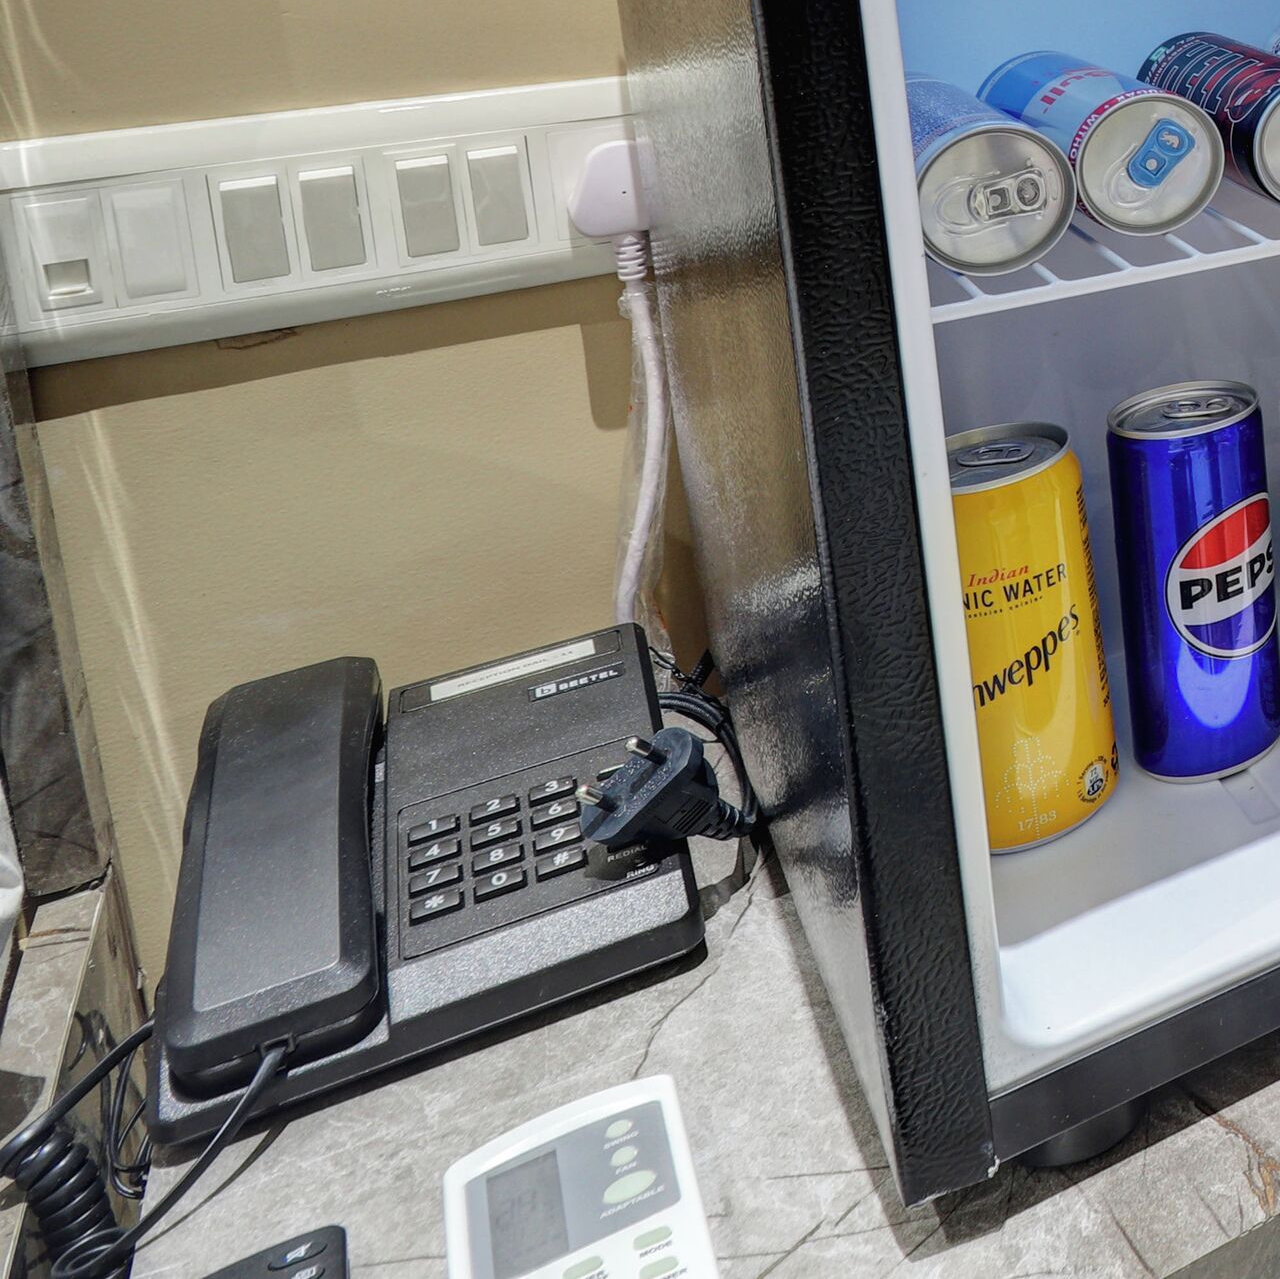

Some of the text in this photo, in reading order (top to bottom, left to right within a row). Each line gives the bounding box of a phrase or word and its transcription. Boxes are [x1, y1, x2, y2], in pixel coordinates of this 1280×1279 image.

[963, 563, 1067, 610] NIC WATER
[968, 565, 1029, 587] Indian
[1179, 538, 1274, 610] PEPS
[558, 670, 618, 691] BEETEL
[428, 780, 559, 831] 1 2 3
[425, 803, 562, 856] 4 5 6
[427, 828, 566, 884] 7 8 9
[607, 844, 648, 863] REDIAL
[603, 1130, 639, 1151] SWING
[615, 1161, 638, 1176] FAN
[600, 1184, 665, 1220] ADAPTABLE
[639, 1239, 673, 1259] MODE
